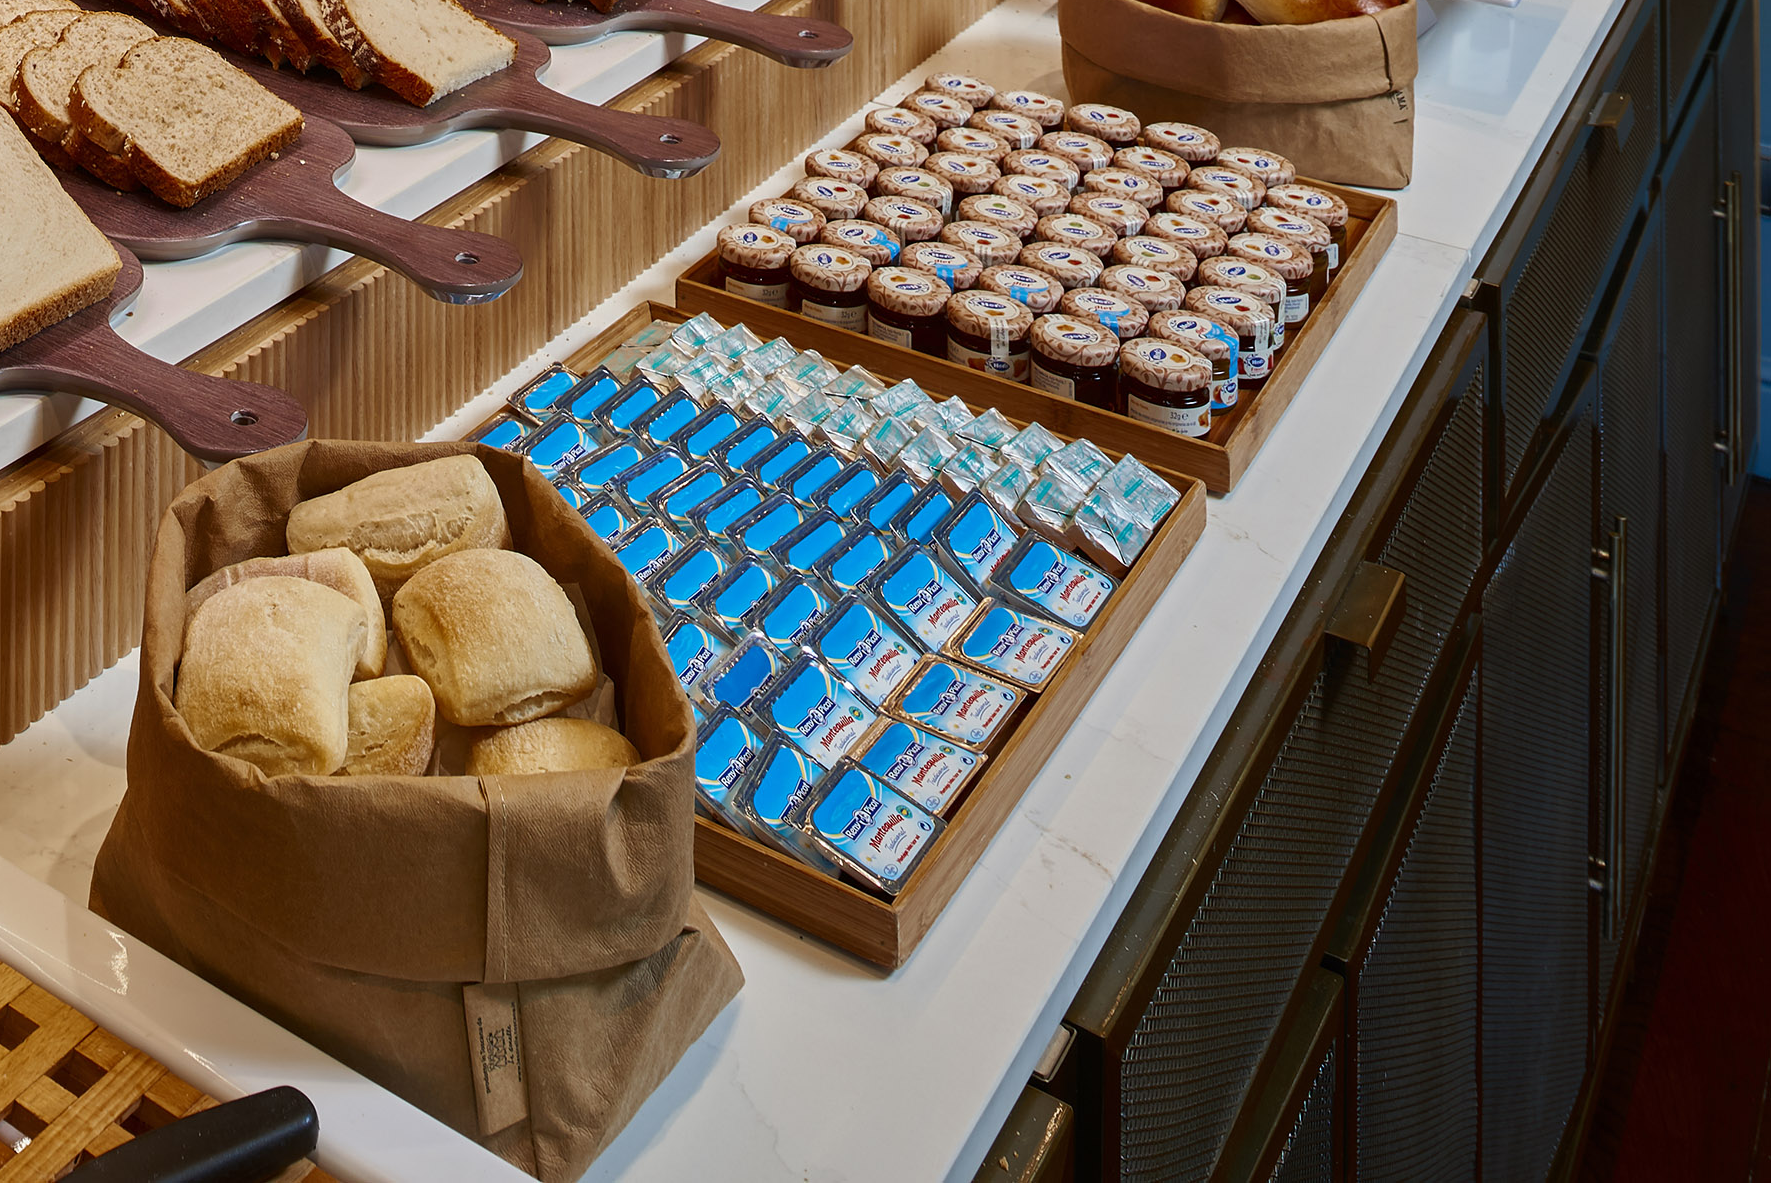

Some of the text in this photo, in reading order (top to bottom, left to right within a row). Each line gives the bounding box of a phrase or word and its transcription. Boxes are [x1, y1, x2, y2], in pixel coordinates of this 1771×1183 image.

[987, 530, 1002, 545] Picot
[1052, 562, 1067, 577] Picot
[927, 582, 942, 597] Picot
[1059, 574, 1087, 604] Mantequilla
[928, 598, 959, 628] Mantequilla
[866, 632, 881, 647] Picot
[1008, 625, 1024, 640] Picot
[1015, 632, 1045, 663] Mantequilla
[698, 650, 711, 663] Picot
[869, 647, 900, 682] Mantequilla
[949, 681, 965, 696] Picot
[819, 698, 835, 713] Picot
[956, 689, 987, 720] Mantequilla
[820, 715, 855, 752] Mantequilla
[738, 749, 754, 765] Picot
[906, 744, 924, 759] Picot
[912, 752, 946, 787] Mantequilla
[797, 781, 811, 797] Picot
[845, 798, 881, 840] Reny Picot
[869, 813, 905, 853] Mantequilla
